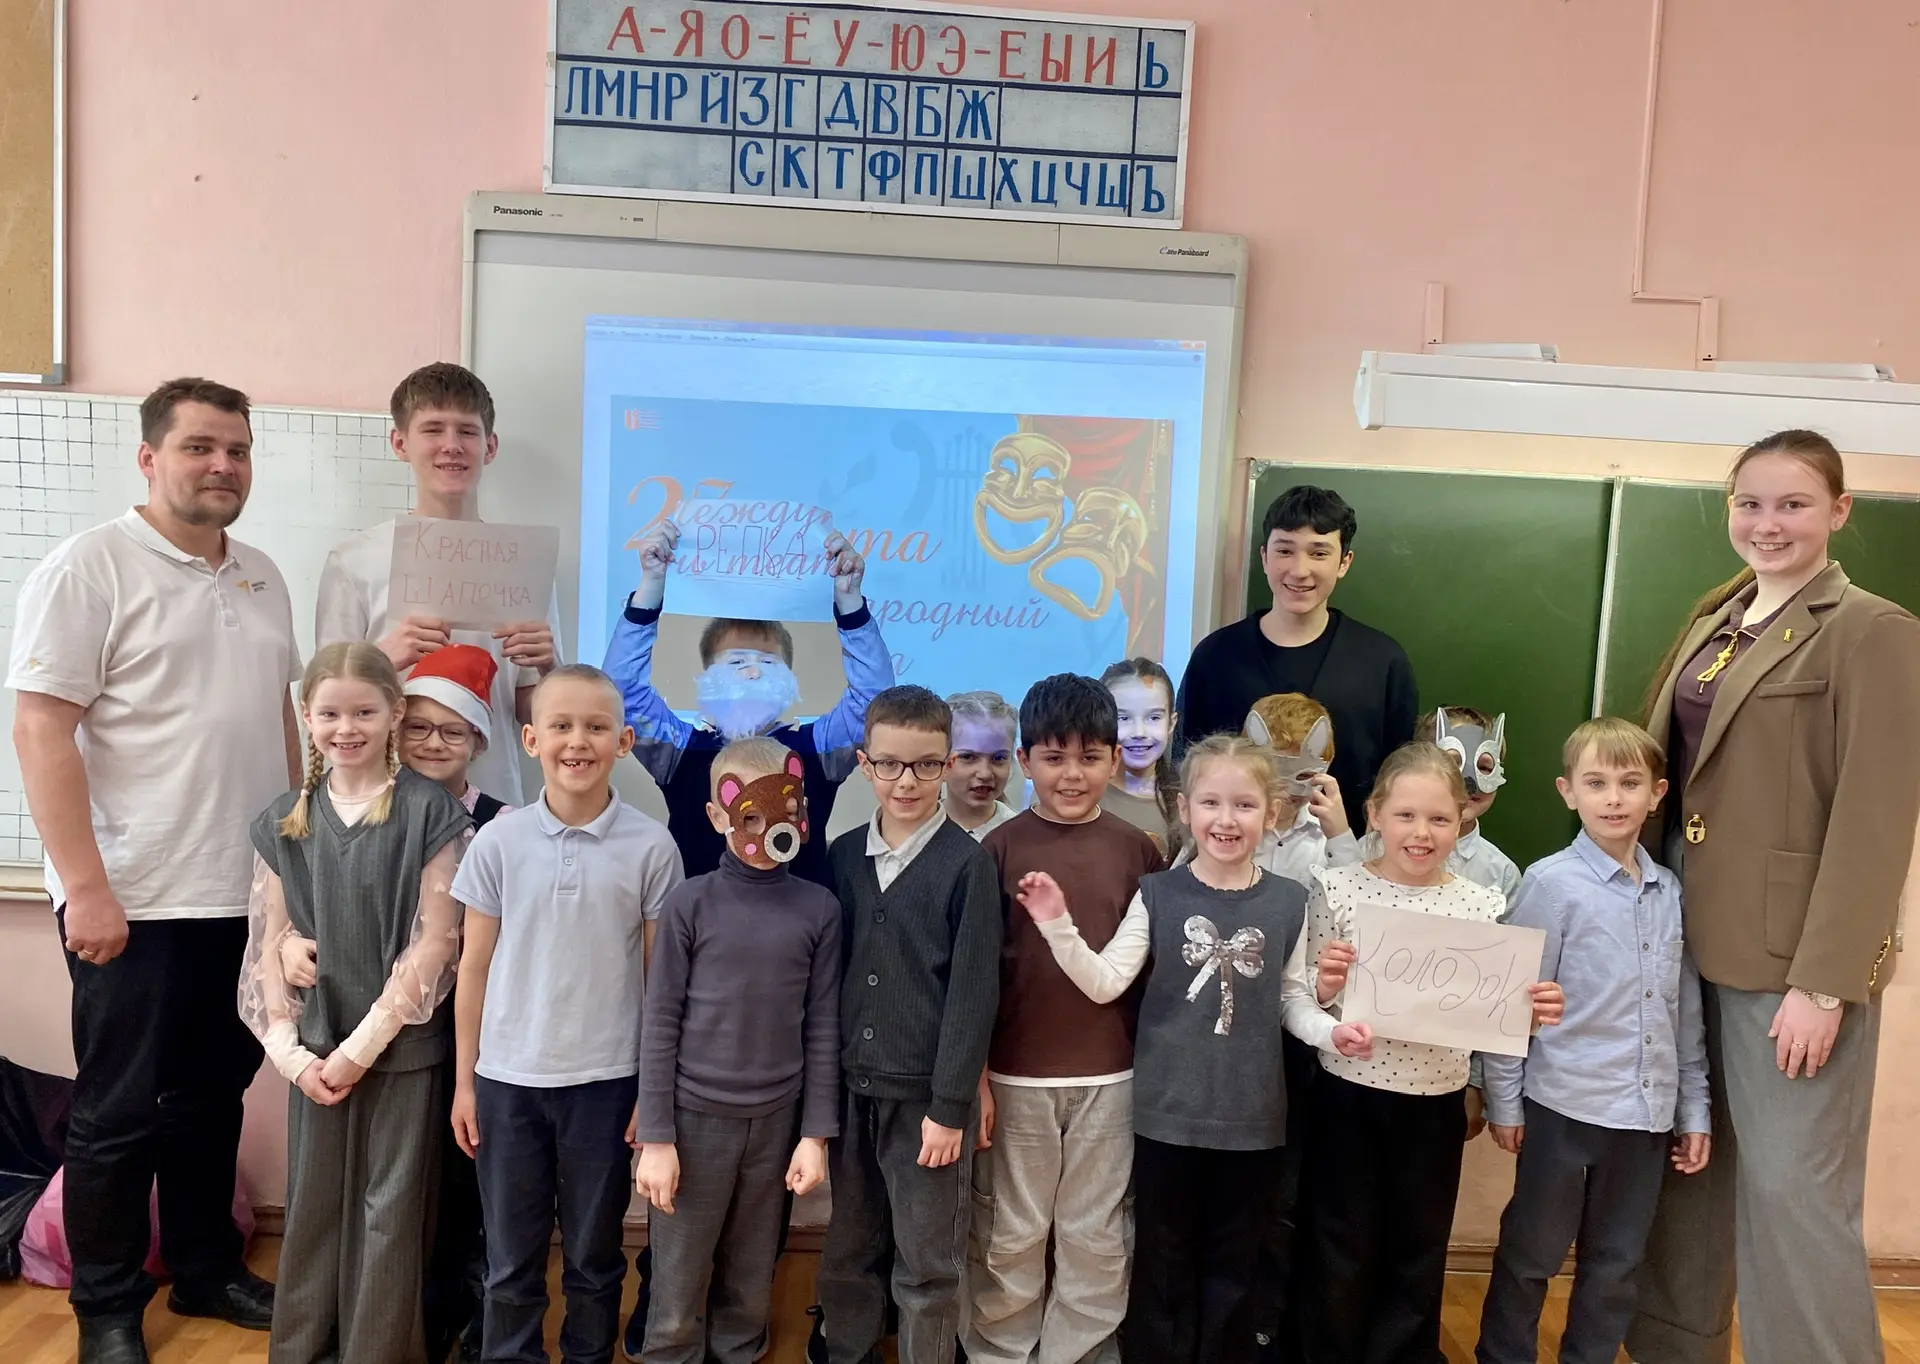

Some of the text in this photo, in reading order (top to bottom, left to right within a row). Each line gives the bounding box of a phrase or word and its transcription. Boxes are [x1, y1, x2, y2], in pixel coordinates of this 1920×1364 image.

[493, 205, 543, 216] Panasonic
[696, 524, 805, 580] РЕПКА
[403, 573, 532, 608] ШАПОЧКА
